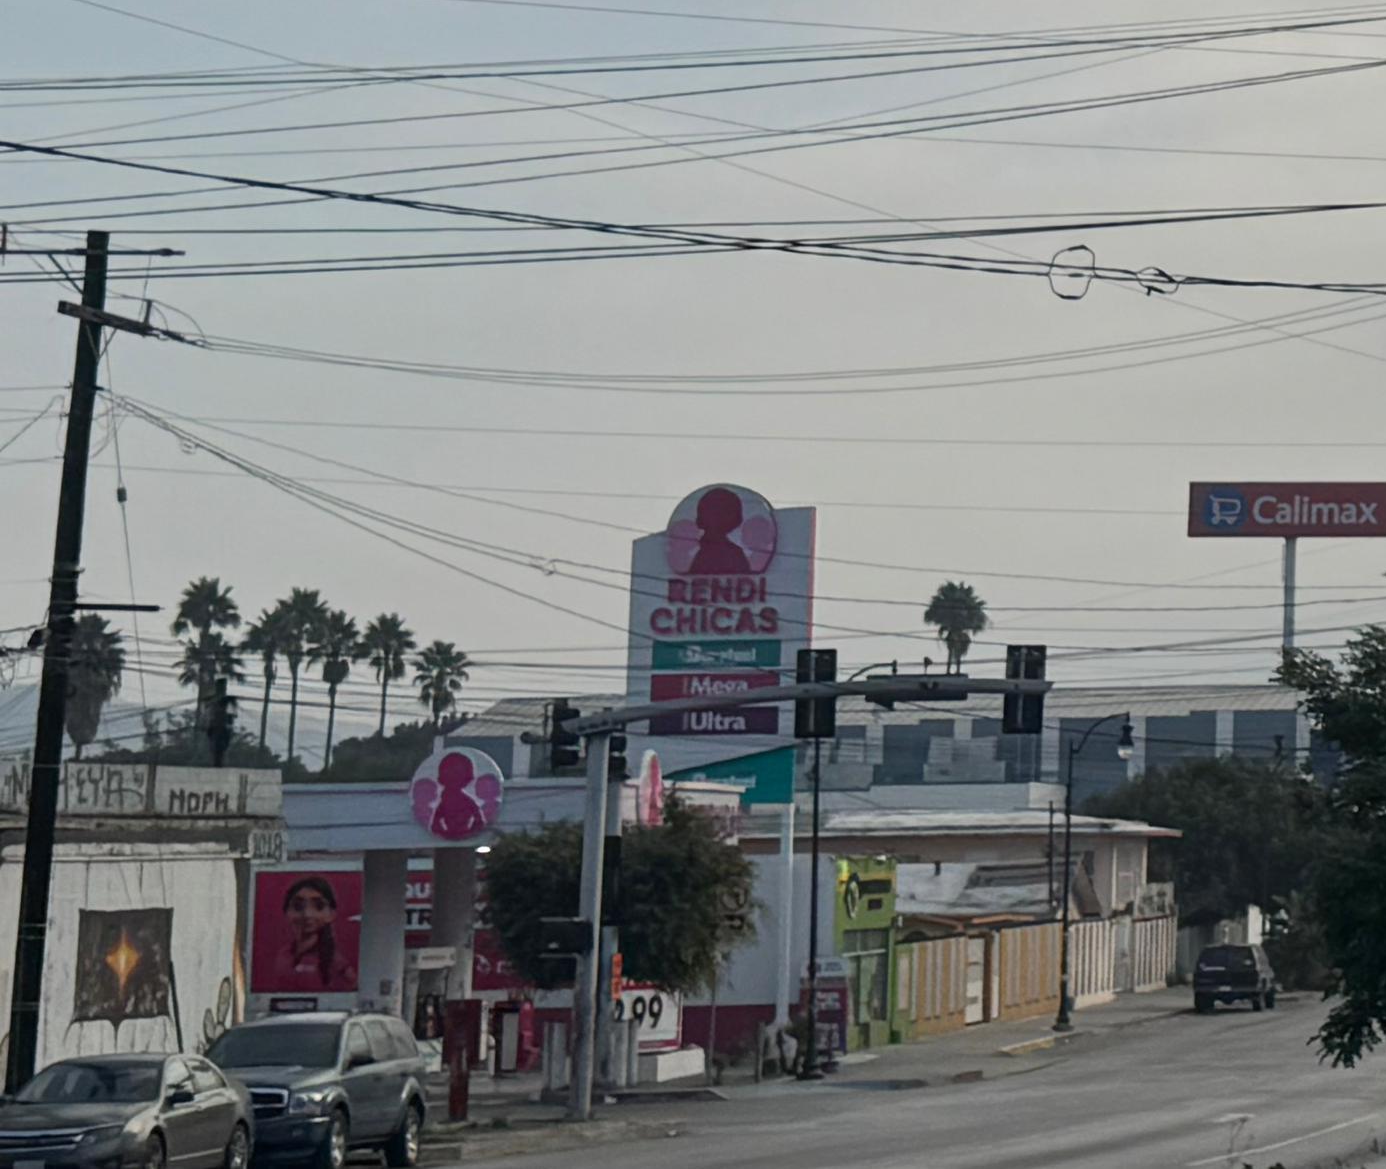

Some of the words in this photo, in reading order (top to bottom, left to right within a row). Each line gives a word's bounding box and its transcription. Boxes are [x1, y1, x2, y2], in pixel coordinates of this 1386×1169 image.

[1252, 494, 1378, 525] Calimax
[667, 578, 768, 605] RENDI
[651, 607, 779, 635] CHICAS
[690, 711, 747, 731] Ultra
